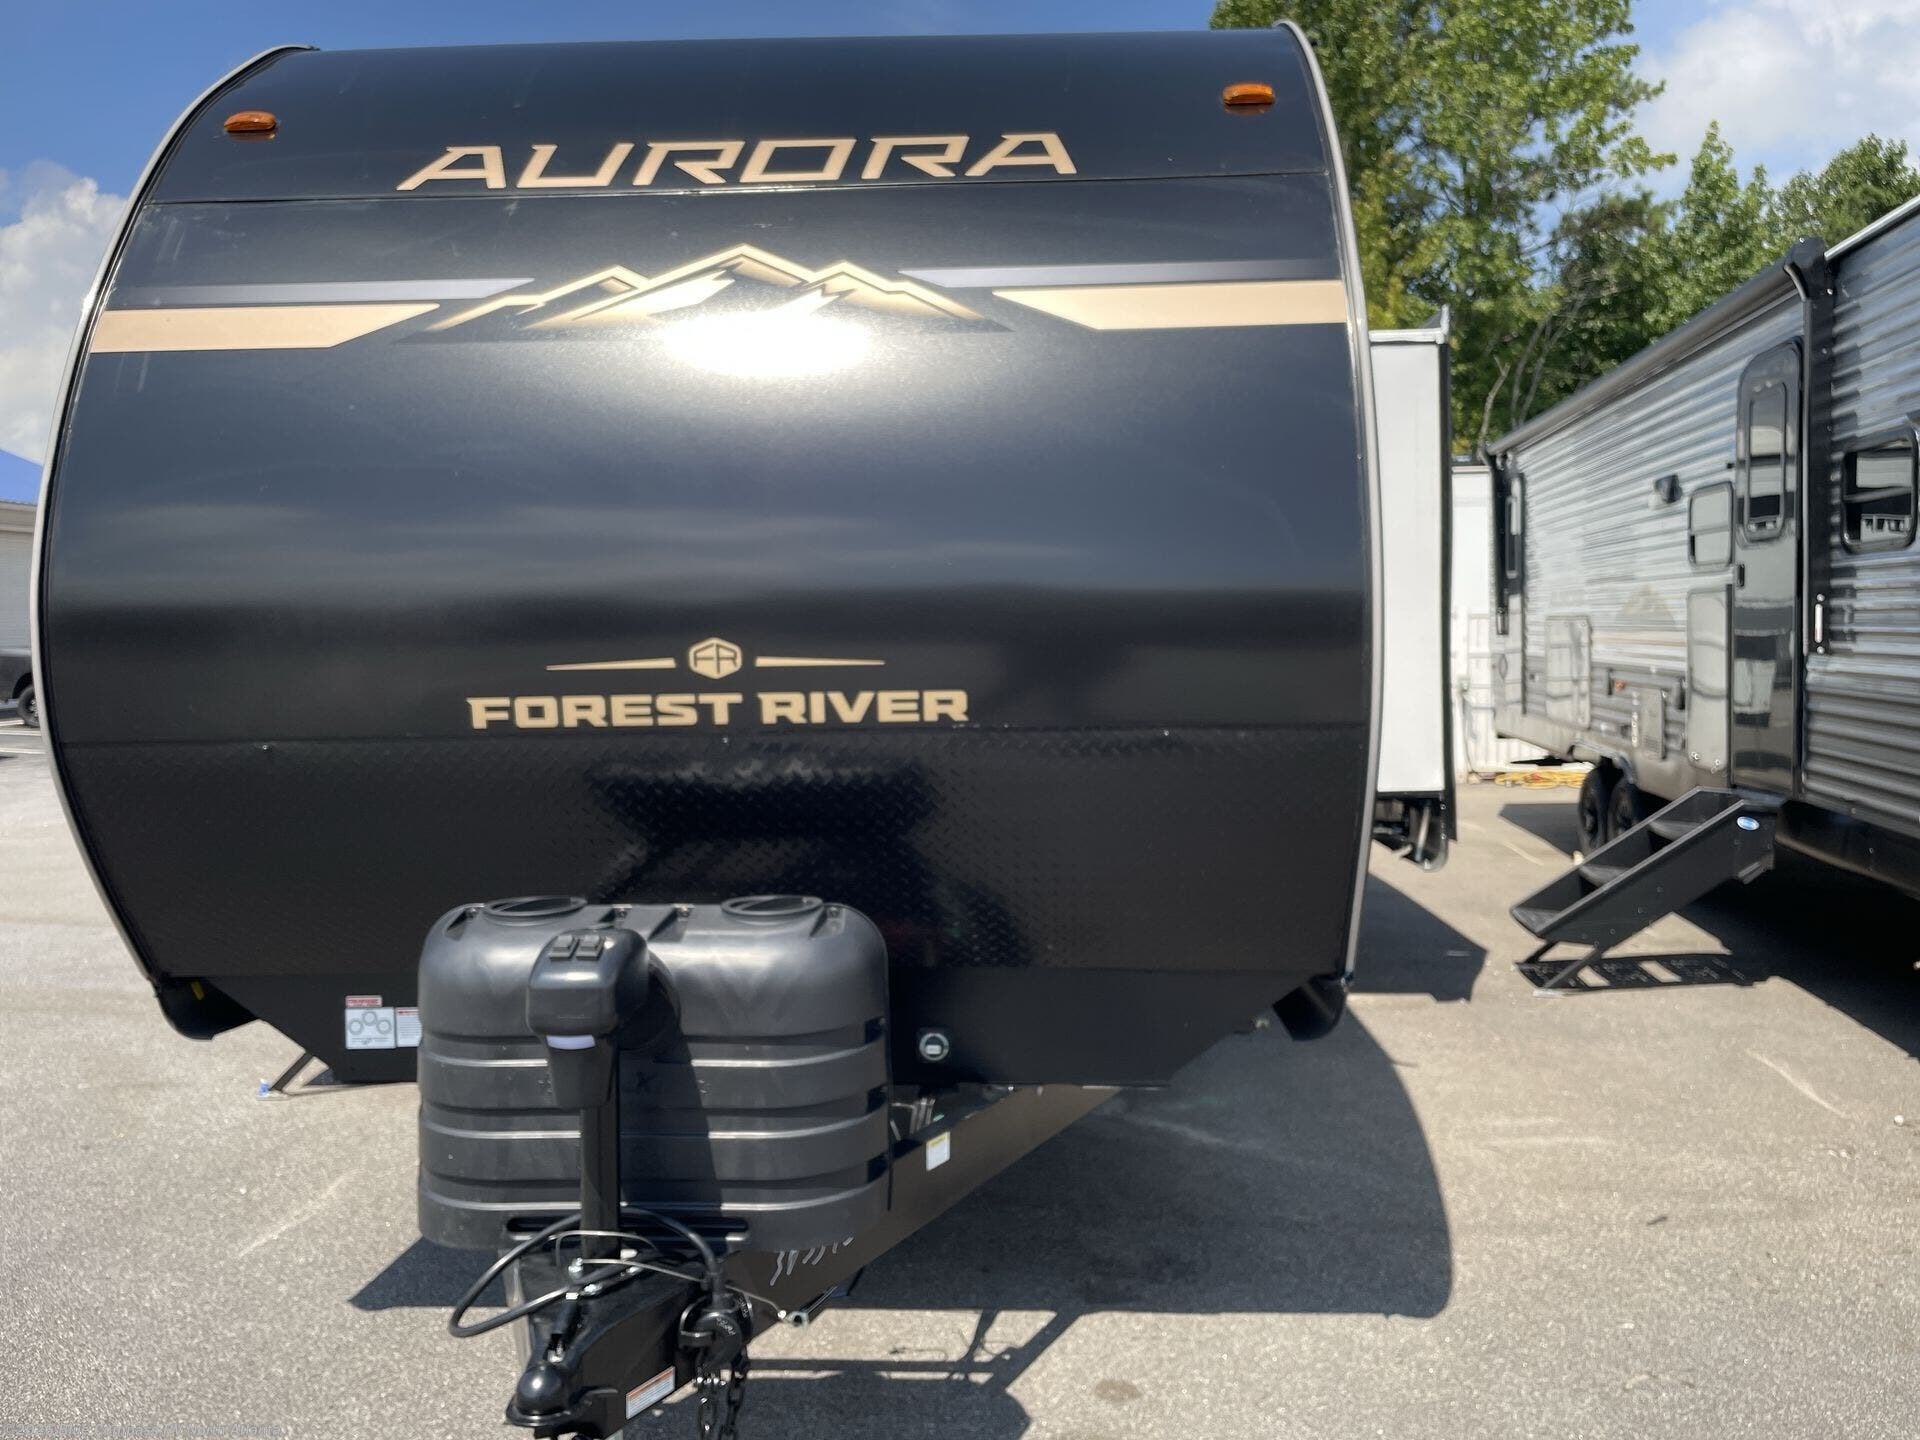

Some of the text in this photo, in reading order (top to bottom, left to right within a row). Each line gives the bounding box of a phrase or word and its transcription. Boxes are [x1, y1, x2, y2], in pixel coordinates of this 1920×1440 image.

[396, 131, 1077, 190] AURORA
[467, 689, 969, 729] FOREST RIVER
